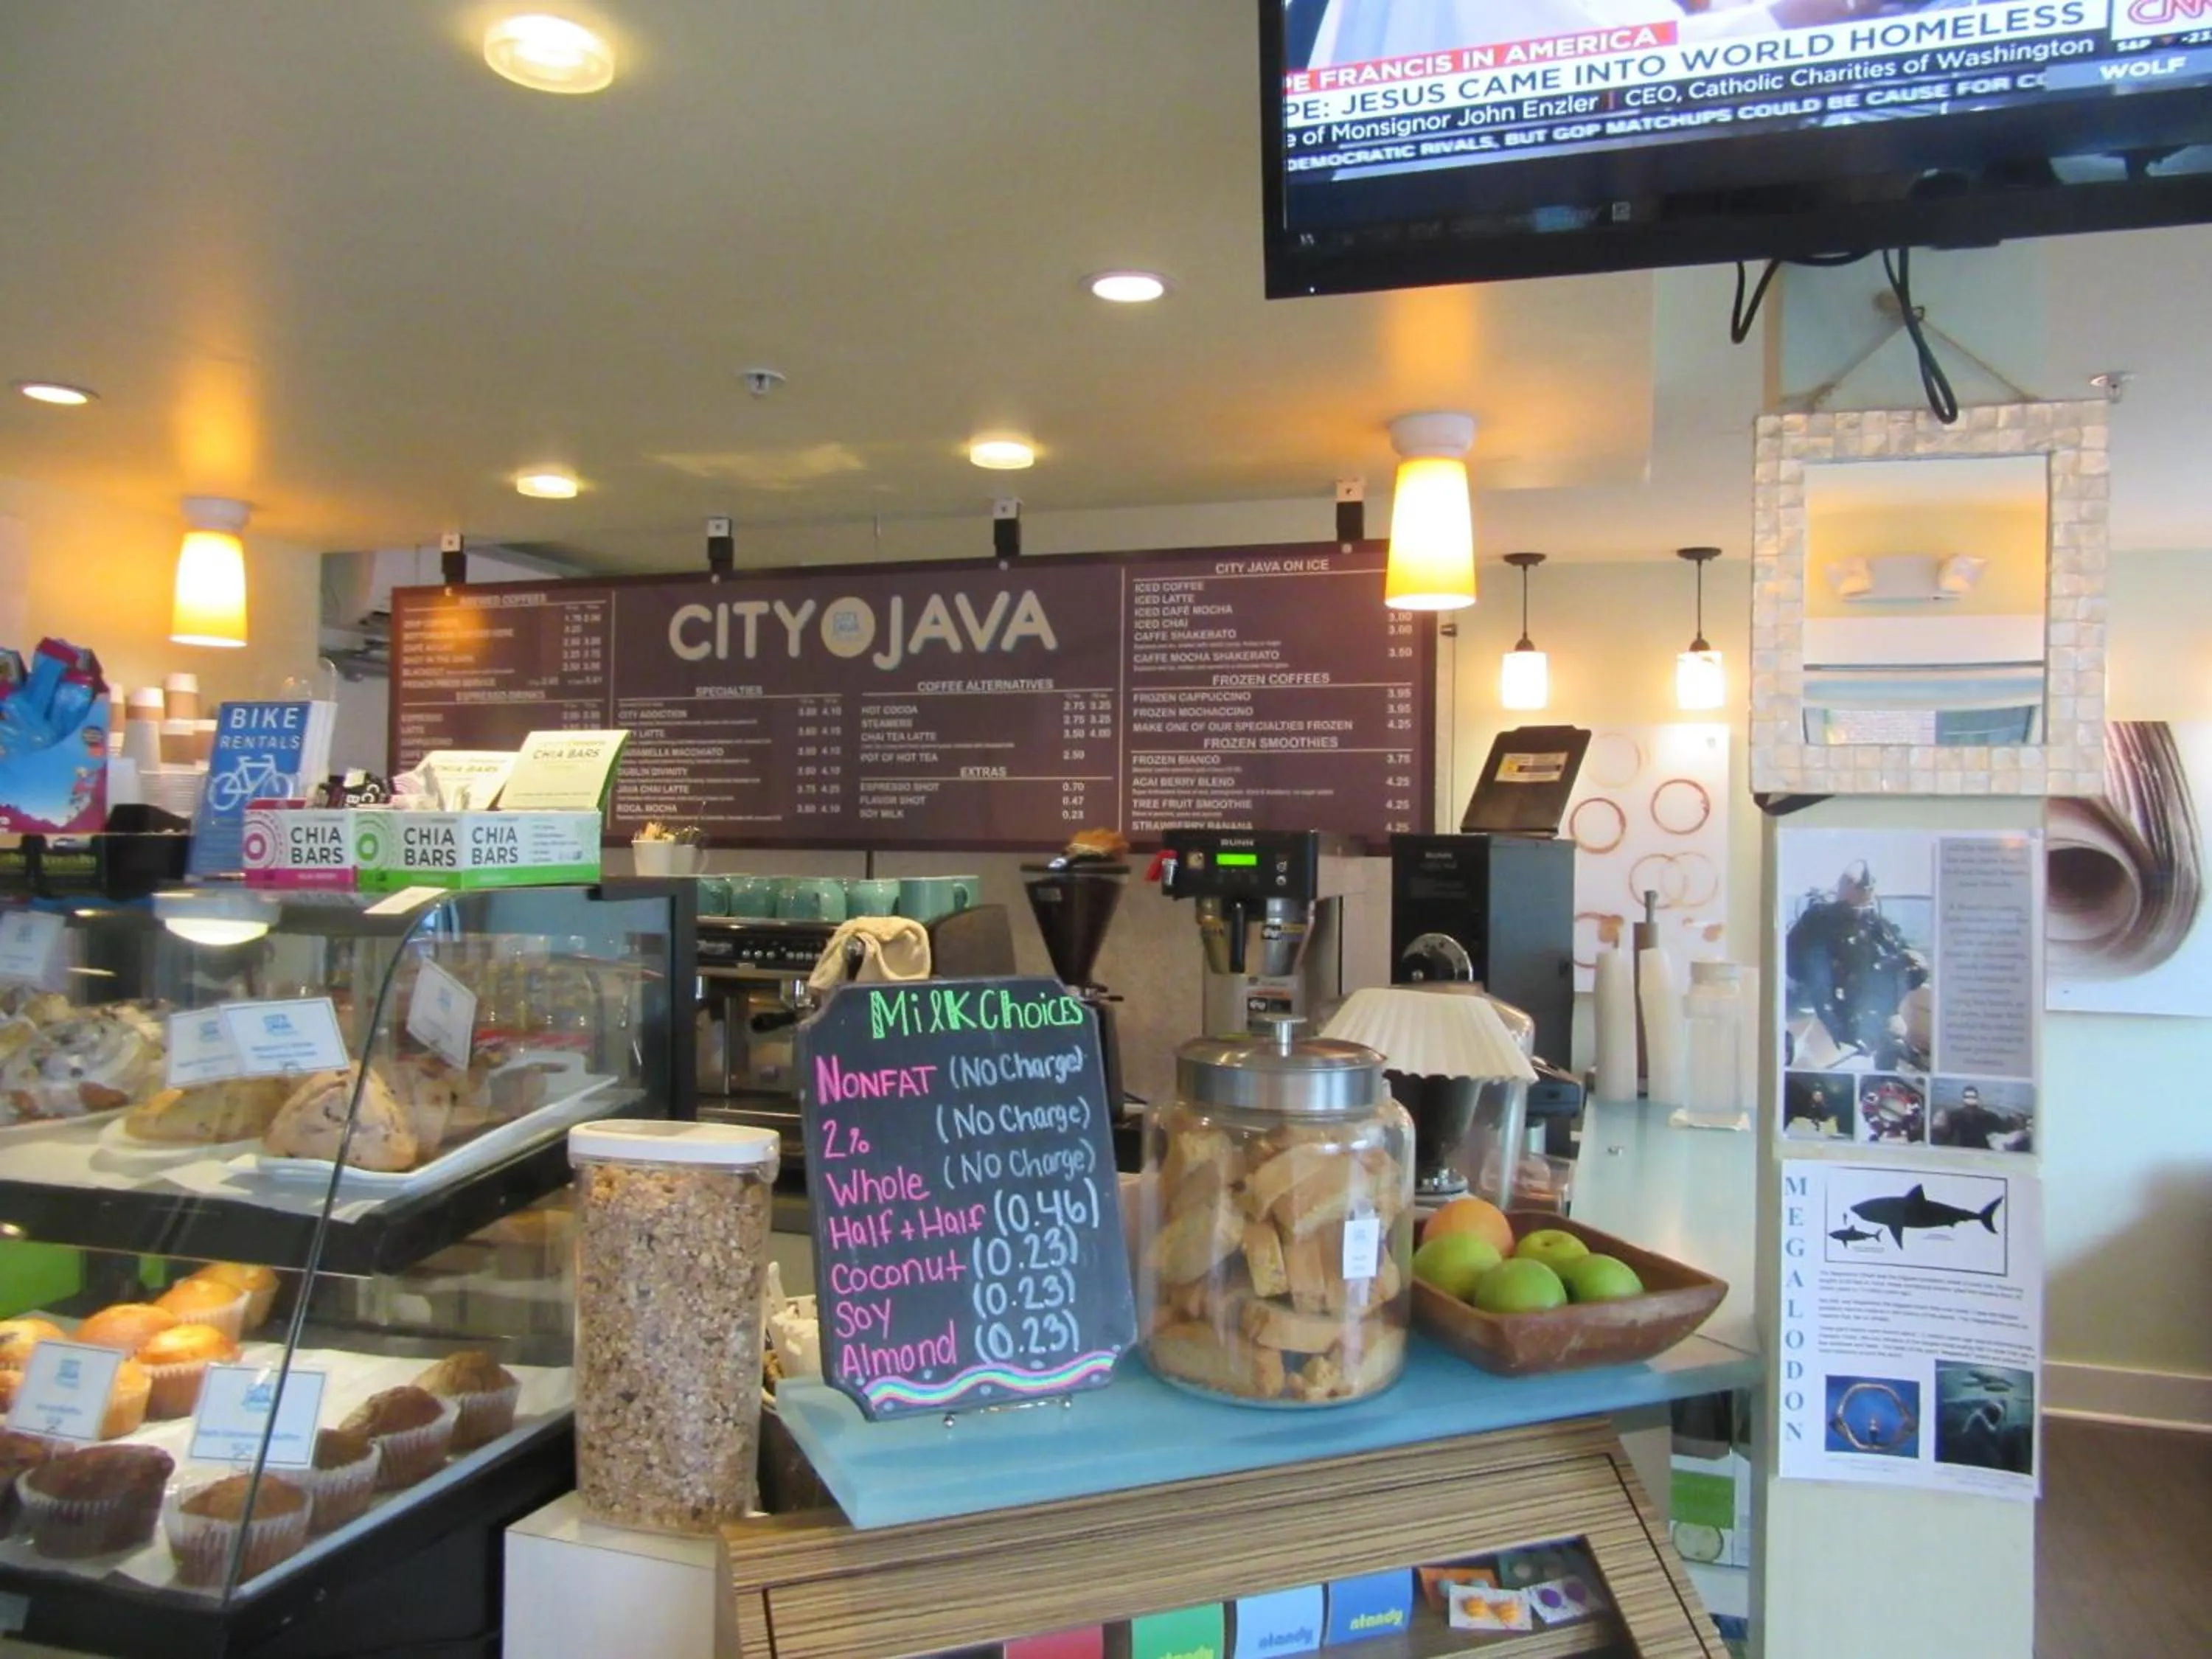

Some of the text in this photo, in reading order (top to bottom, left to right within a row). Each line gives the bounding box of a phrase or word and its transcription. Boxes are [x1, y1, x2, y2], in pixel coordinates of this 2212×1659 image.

[1319, 55, 1453, 89] FRANCIS
[1462, 48, 1495, 69] IN
[1505, 27, 1658, 64] AMERICA
[1340, 83, 1446, 116] JESUS
[1458, 68, 1562, 100] CAME
[1575, 55, 1666, 86] INTO
[1680, 34, 1834, 72] WORLD
[1850, 1, 2085, 52] HOMELESS
[2099, 56, 2188, 80] WOLF
[1301, 125, 1326, 146] of
[1332, 113, 1451, 144] Monsignor
[1457, 105, 1516, 128] John
[1523, 93, 1599, 119] Enzler
[1624, 85, 1683, 108] CEO,
[1688, 72, 1784, 100] Catholic
[1790, 62, 1896, 87] Charities
[1902, 53, 1931, 74] of
[1936, 36, 2095, 70] Washington
[1287, 143, 1416, 173] DEMOCRATIC
[1504, 128, 1547, 146] BUT
[1552, 122, 1600, 142] GOP
[1605, 107, 1732, 136] MATCHUPS
[1737, 97, 1821, 120] COULD
[1827, 91, 1860, 110] BE
[1866, 82, 1951, 106] CAUSE
[1956, 77, 2011, 97] FOR
[1216, 559, 1329, 574] CITY JAVA ON ICE
[1135, 581, 1204, 592] ICED COFFEE
[1135, 594, 1194, 604] ICED LATTE
[1135, 607, 1160, 616] ICED
[1193, 605, 1233, 615] MOCHA
[669, 590, 1058, 670] CITY JAVA
[1134, 619, 1160, 629] ICED
[1170, 651, 1210, 662] MOCHA
[917, 679, 1054, 692] COFFEE ALTERNATIVES
[1213, 673, 1330, 686] FROZEN COFFEES
[1133, 693, 1177, 703] FROZEN
[230, 707, 299, 729] BIKE
[1133, 708, 1177, 717] FROZEN
[1307, 720, 1353, 730] FROZEN
[220, 735, 301, 750] RENTALS
[1204, 737, 1338, 749] FROZEN SMOOTHIES
[1133, 755, 1176, 765] FROZEN
[291, 827, 342, 845] CHIA
[404, 827, 456, 846] CHIA
[472, 826, 518, 844] CHIA
[291, 847, 344, 865] BARS
[404, 848, 456, 867] BARS
[472, 846, 519, 865] BARS
[823, 1119, 871, 1159] 2%
[825, 1166, 931, 1209] Whole
[994, 1178, 1100, 1237] (0.46)
[973, 1223, 1079, 1280] (0.23)
[973, 1268, 1075, 1319] (0.23)
[843, 1309, 1079, 1379] Almond (0.23)
